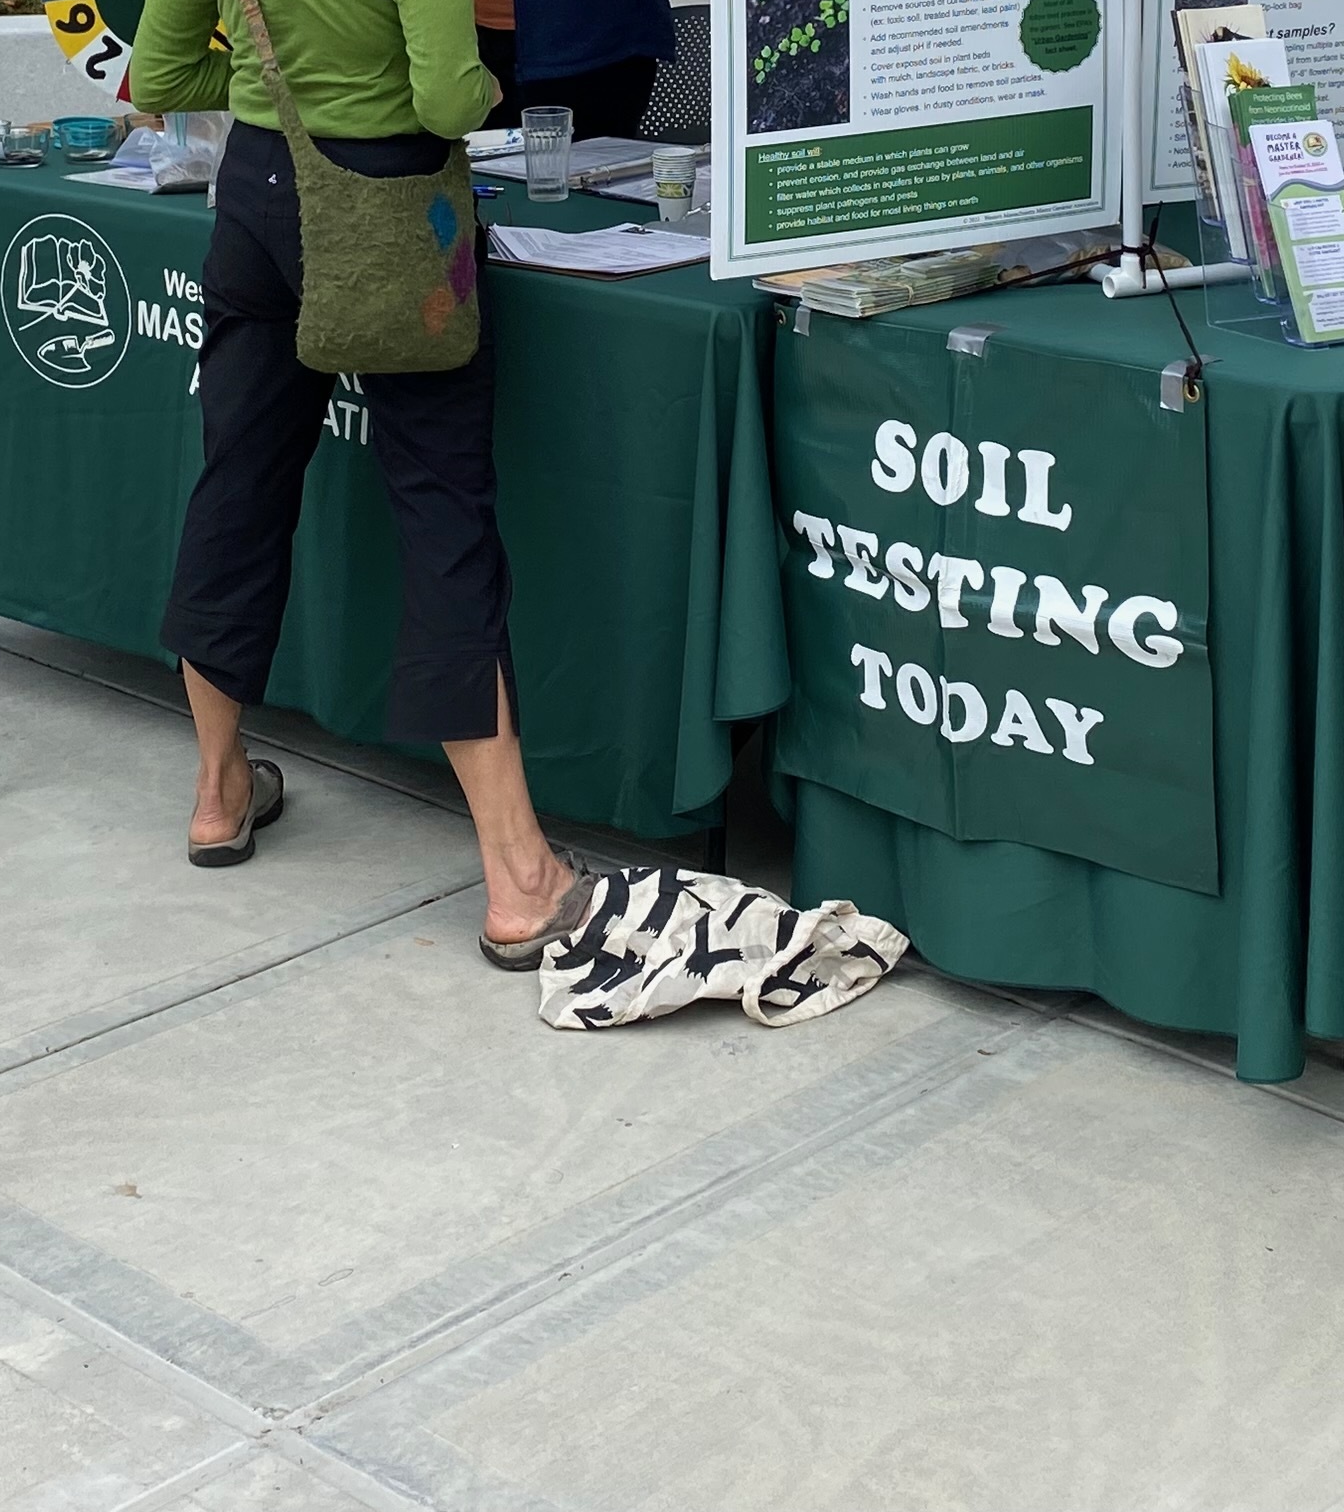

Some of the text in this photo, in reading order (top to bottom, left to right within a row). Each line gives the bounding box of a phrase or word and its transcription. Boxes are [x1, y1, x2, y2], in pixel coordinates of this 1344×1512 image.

[1276, 22, 1336, 40] samples?
[85, 35, 123, 80] 2
[1248, 106, 1262, 114] from
[1252, 92, 1302, 102] Protecting Bees
[1265, 133, 1291, 141] BECOME
[1266, 141, 1301, 153] MASTER
[776, 143, 970, 176] provide a stable medium in which plants can grow
[163, 268, 205, 304] Wes
[137, 300, 204, 350] MAS
[871, 419, 1073, 531] SOIL
[793, 509, 1185, 669] TESTING
[850, 642, 1105, 765] TODAY
